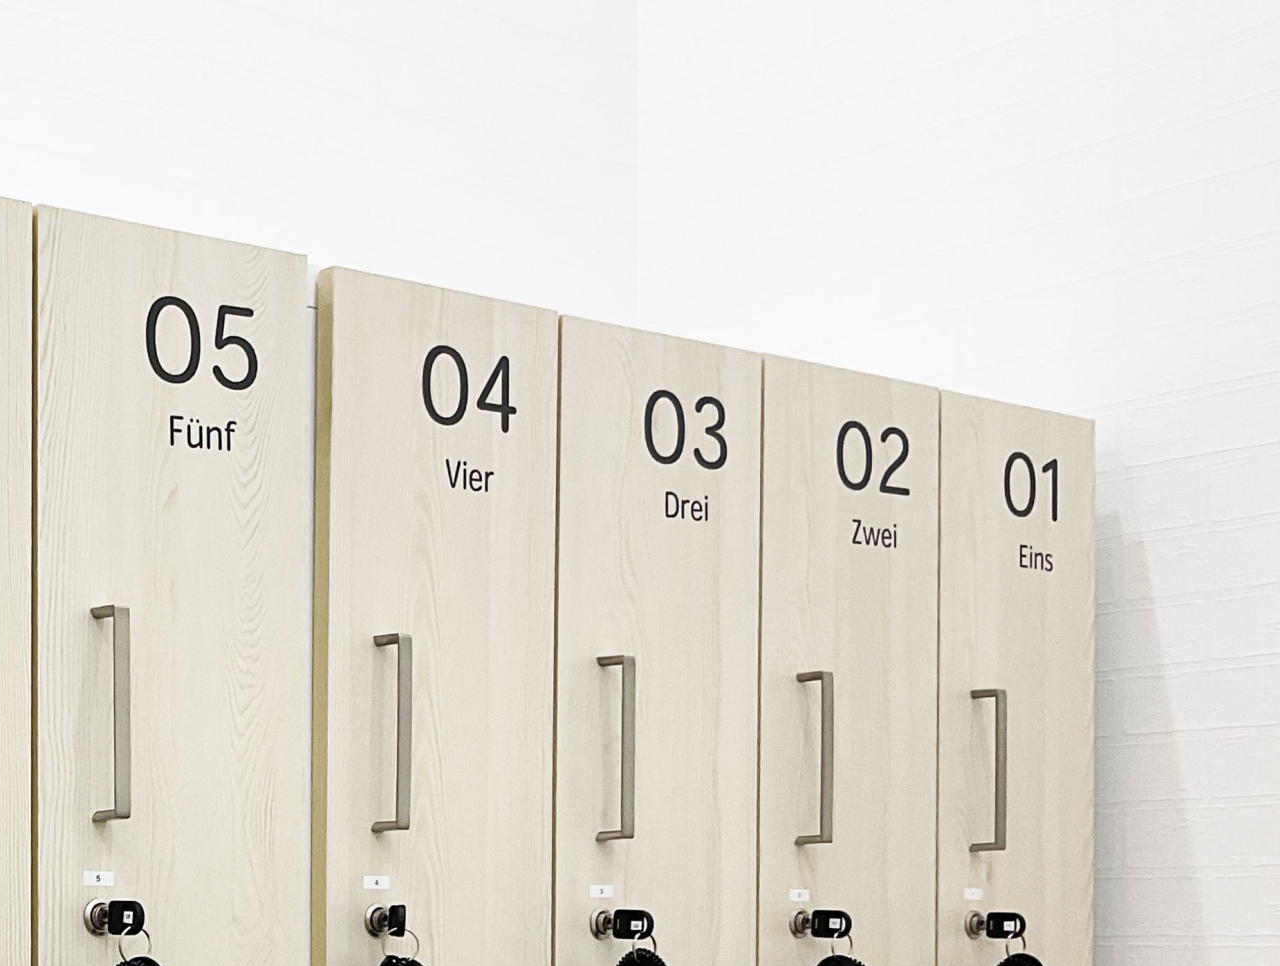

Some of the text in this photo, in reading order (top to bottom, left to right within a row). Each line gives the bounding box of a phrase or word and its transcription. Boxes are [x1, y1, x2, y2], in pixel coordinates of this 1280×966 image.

[145, 295, 258, 391] 05
[422, 344, 517, 434] 04
[169, 415, 237, 452] Fünf
[644, 389, 728, 470] 03
[445, 458, 495, 493] Vier
[836, 420, 910, 496] 02
[665, 491, 709, 522] Drei
[1003, 451, 1058, 522] 01
[852, 518, 897, 548] Zwei
[1019, 544, 1054, 572] Eins
